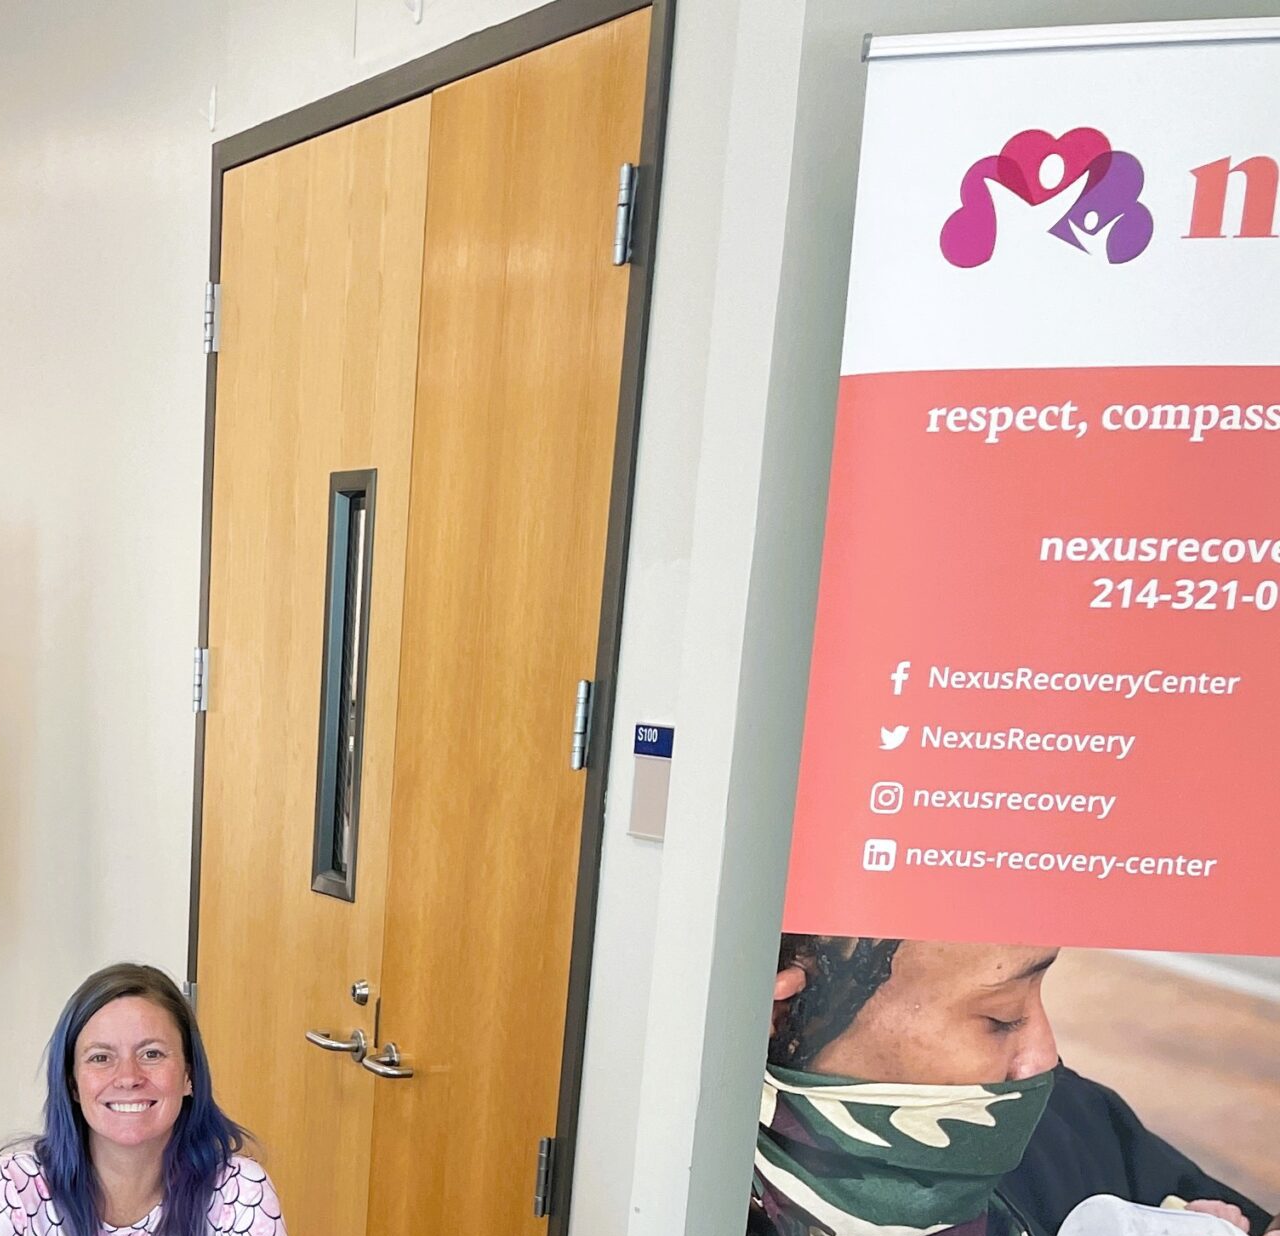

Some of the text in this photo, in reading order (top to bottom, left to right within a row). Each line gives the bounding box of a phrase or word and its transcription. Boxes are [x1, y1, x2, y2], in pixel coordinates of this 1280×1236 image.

[926, 400, 1280, 443] respect, compass
[1090, 578, 1277, 610] 214-321-0
[929, 666, 1240, 698] NexusRecoveryCenter
[637, 727, 658, 743] S100
[921, 726, 1135, 759] NexusRecovery
[913, 788, 1116, 819] nexusrecovery
[906, 846, 1217, 879] nexus-recovery-center
